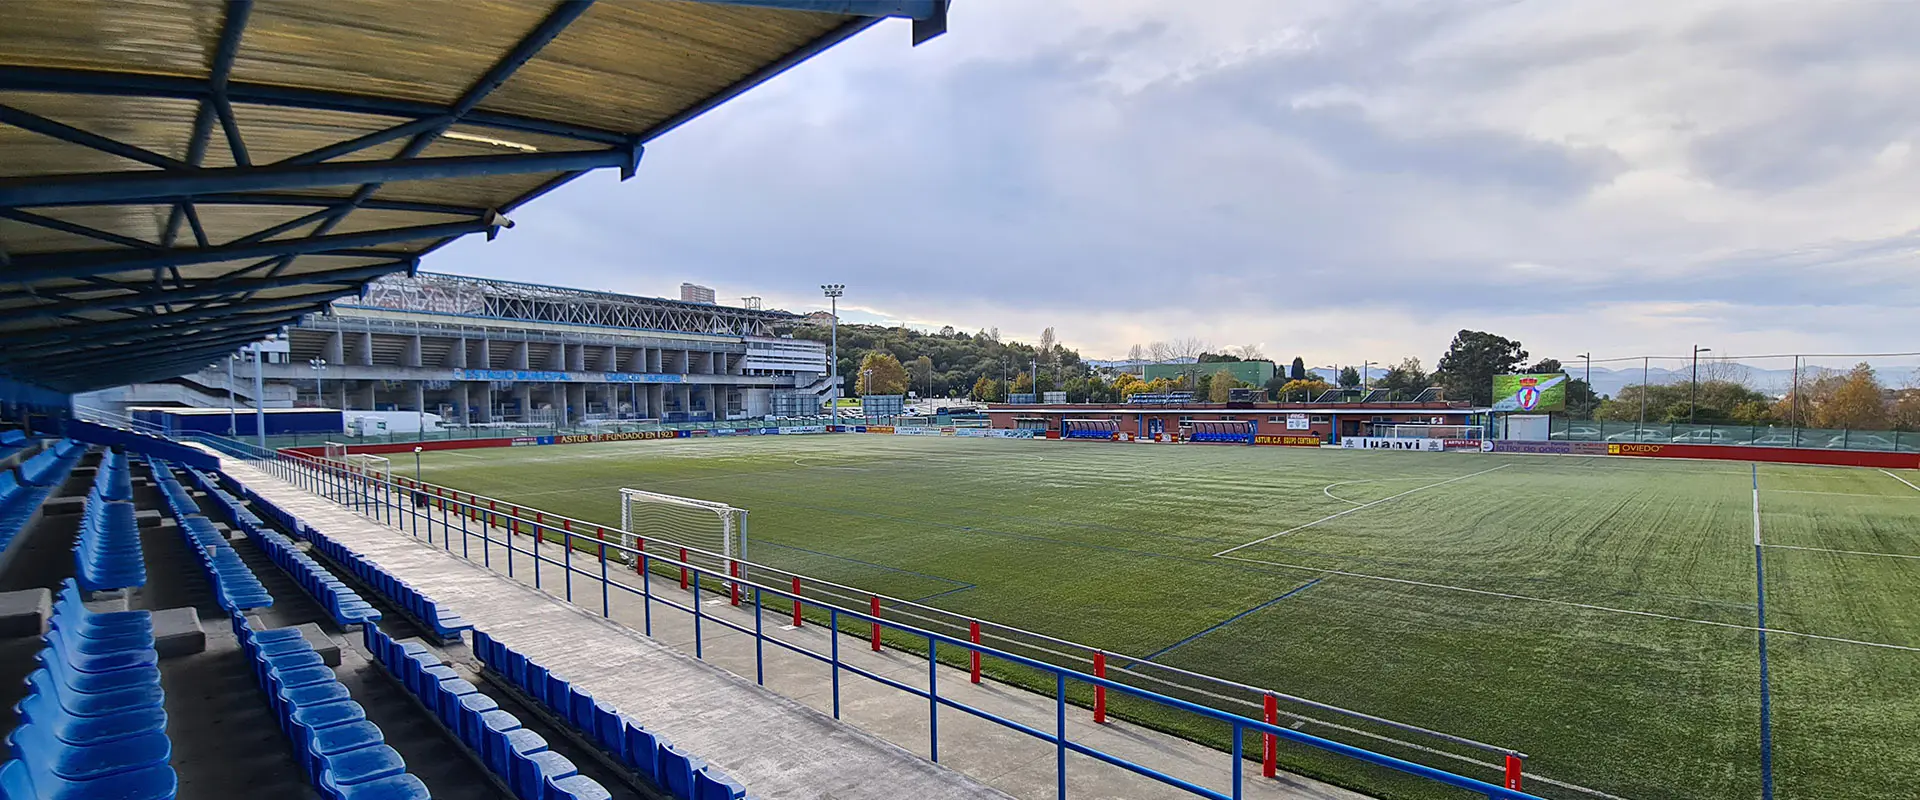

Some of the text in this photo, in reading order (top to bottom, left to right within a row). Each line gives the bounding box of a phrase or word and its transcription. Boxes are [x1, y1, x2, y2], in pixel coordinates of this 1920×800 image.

[560, 435, 589, 444] ASTUR
[606, 432, 644, 441] FUNDADO
[645, 431, 656, 439] EN
[1363, 438, 1420, 450] luanvi
[1622, 444, 1659, 452] OVIEDO
